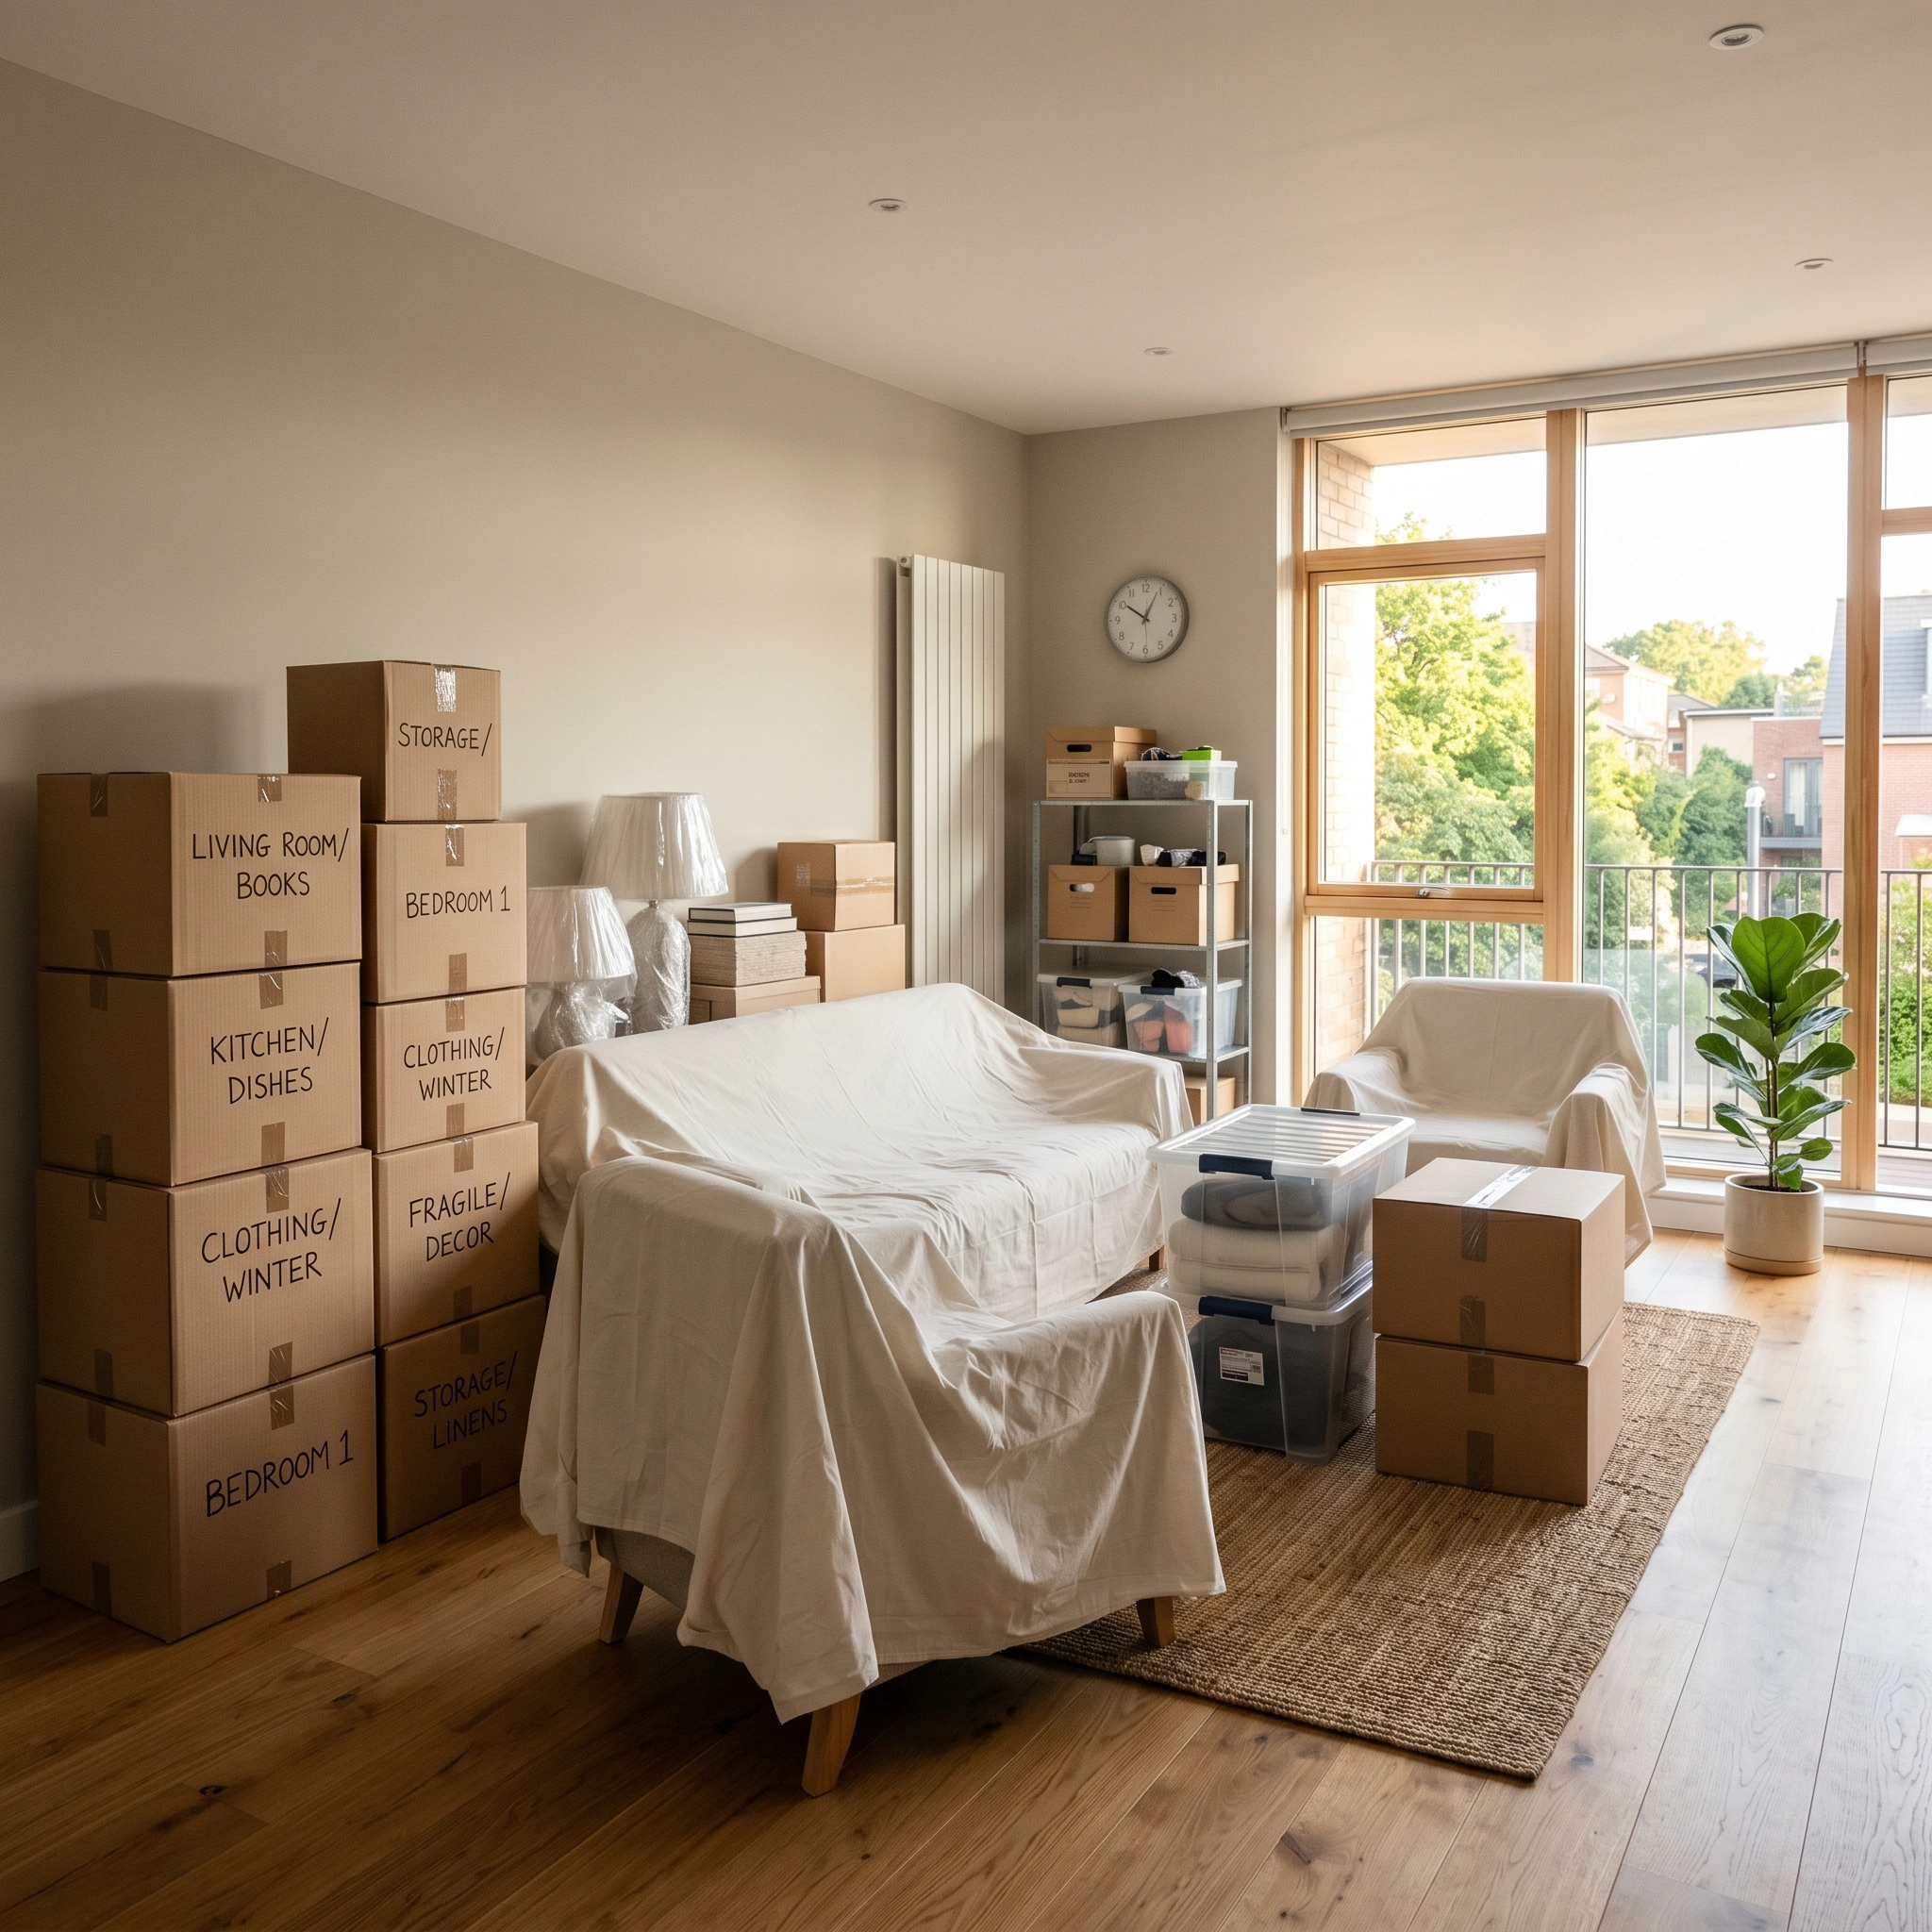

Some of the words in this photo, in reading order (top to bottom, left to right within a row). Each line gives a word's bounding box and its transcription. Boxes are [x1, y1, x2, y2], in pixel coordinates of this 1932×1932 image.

[1128, 589, 1135, 598] 11
[1141, 584, 1150, 592] 12
[1168, 597, 1174, 608] 2
[1115, 616, 1121, 625] 9
[1119, 601, 1126, 609] 10
[1172, 613, 1177, 623] 3
[1119, 632, 1124, 641] 8
[1129, 642, 1135, 651] 7
[1142, 645, 1148, 654] 6
[1158, 641, 1163, 650] 5
[1168, 629, 1174, 638] 4
[397, 723, 492, 756] STORAGE/
[192, 832, 271, 859] LIVING
[282, 827, 349, 862] ROOM/
[237, 871, 311, 899] BOOKS
[406, 890, 494, 919] BEDROOM
[499, 885, 511, 912] 1
[209, 1017, 330, 1065] KITCHEN/
[403, 1027, 506, 1069] CLOTHING/
[227, 1066, 314, 1105] DISHES
[419, 1069, 492, 1102] WINTER
[408, 1172, 511, 1227] FRAGILE/
[201, 1197, 342, 1264] CLOTHING/
[425, 1220, 495, 1262] DECOR
[223, 1251, 323, 1303] WINTER
[413, 1351, 518, 1419] STORAGE/
[432, 1398, 508, 1450] LINENS
[207, 1440, 329, 1517] BEDROOM
[339, 1429, 355, 1466] 1
